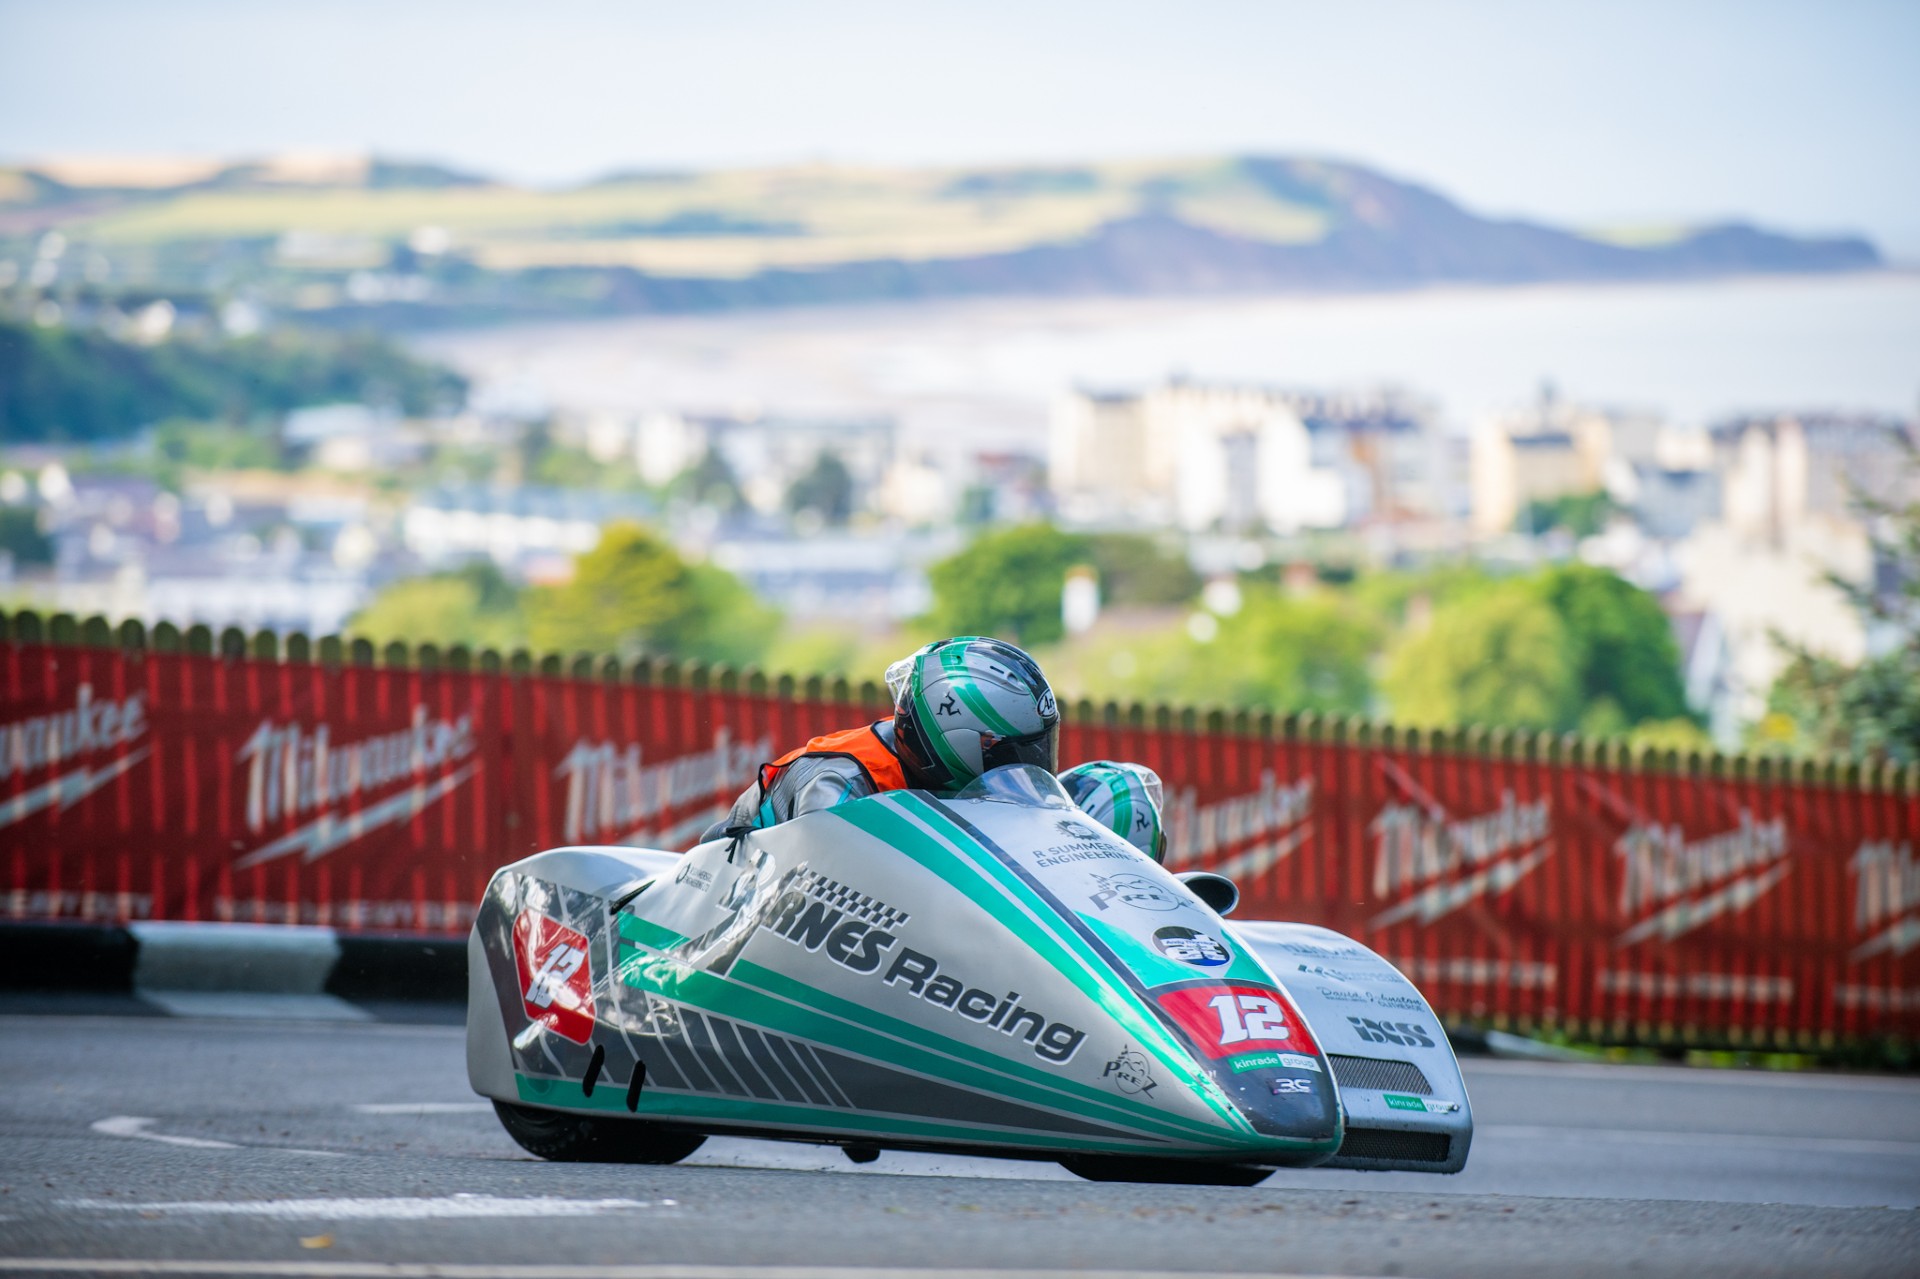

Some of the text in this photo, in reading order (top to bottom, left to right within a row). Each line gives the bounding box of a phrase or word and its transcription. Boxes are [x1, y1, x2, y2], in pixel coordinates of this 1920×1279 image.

[237, 702, 476, 833] Milwaukee
[882, 947, 1088, 1065] Racing
[1208, 994, 1290, 1045] 12
[1234, 1056, 1316, 1069] kinrade group
[1387, 1098, 1423, 1110] kinrade
